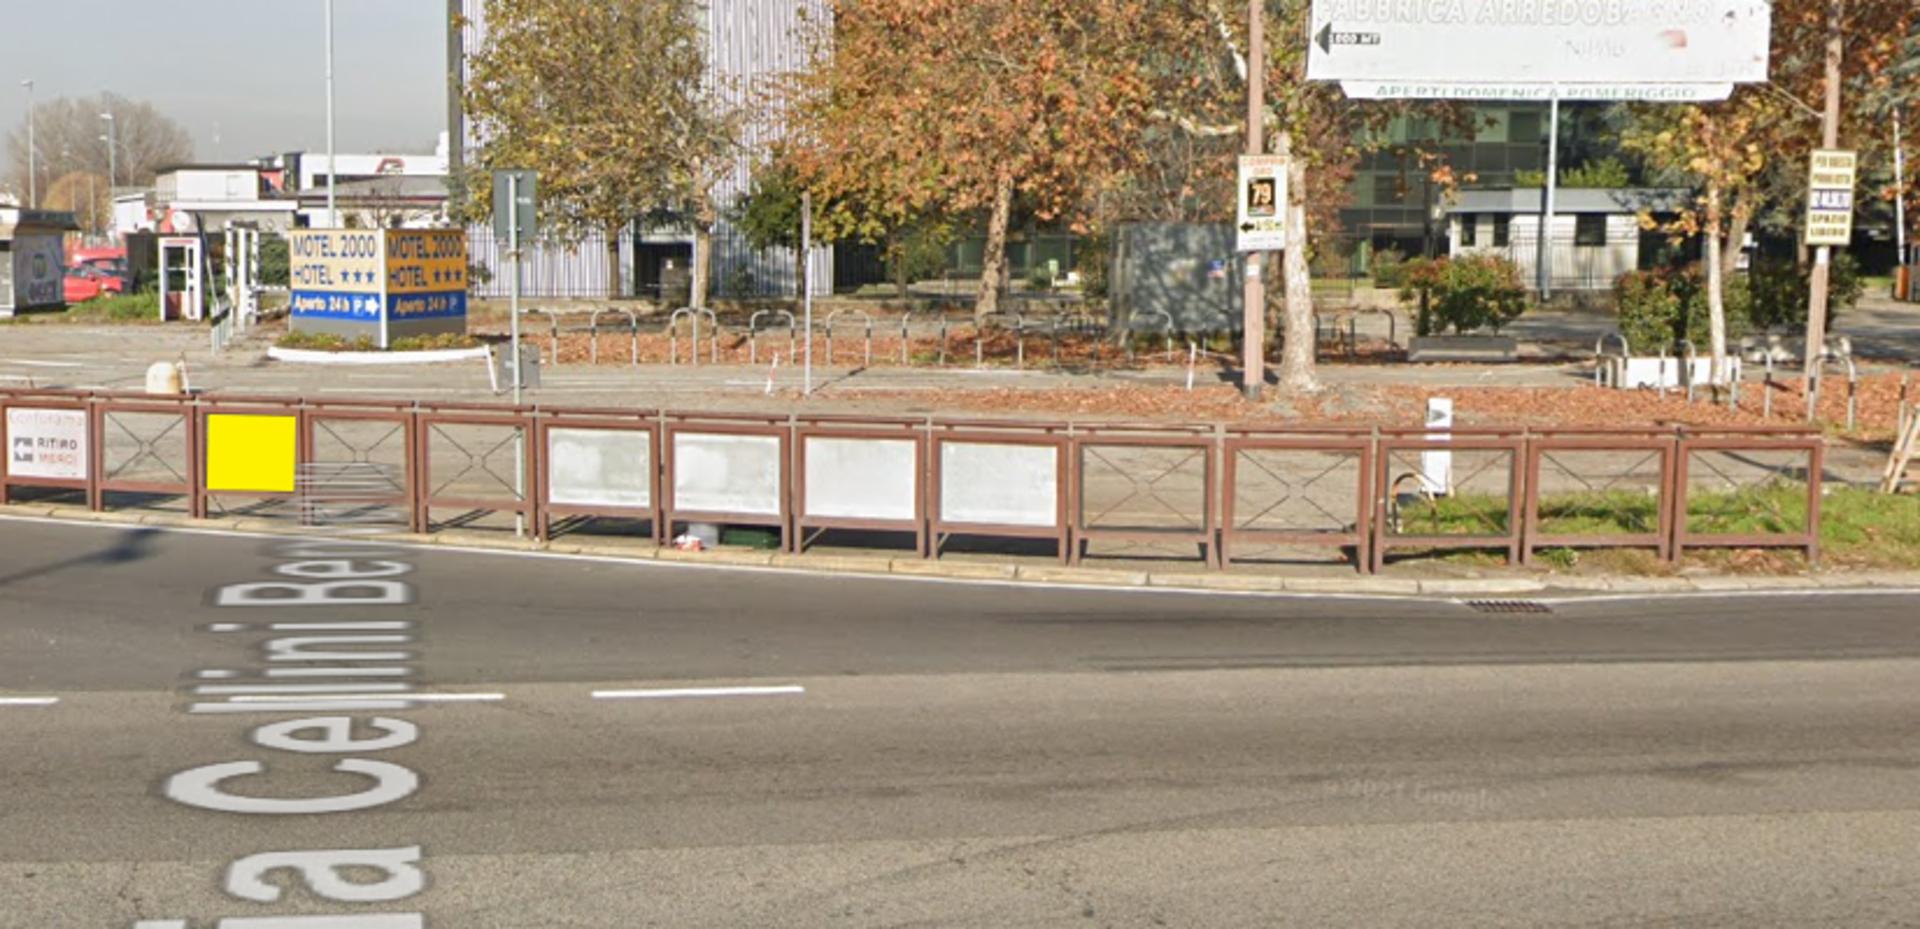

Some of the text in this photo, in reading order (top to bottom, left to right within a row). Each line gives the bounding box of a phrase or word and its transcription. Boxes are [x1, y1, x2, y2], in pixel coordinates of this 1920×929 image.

[1375, 85, 1447, 97] APERTI
[1251, 182, 1272, 205] 79
[293, 234, 376, 258] MOTEL 2000
[388, 235, 462, 259] MOTEL 2000
[294, 264, 335, 286] HOTEL
[389, 265, 428, 288] HOTEL
[294, 294, 327, 314] Aperto
[394, 298, 425, 315] Aperto
[37, 437, 78, 450] RITIRO
